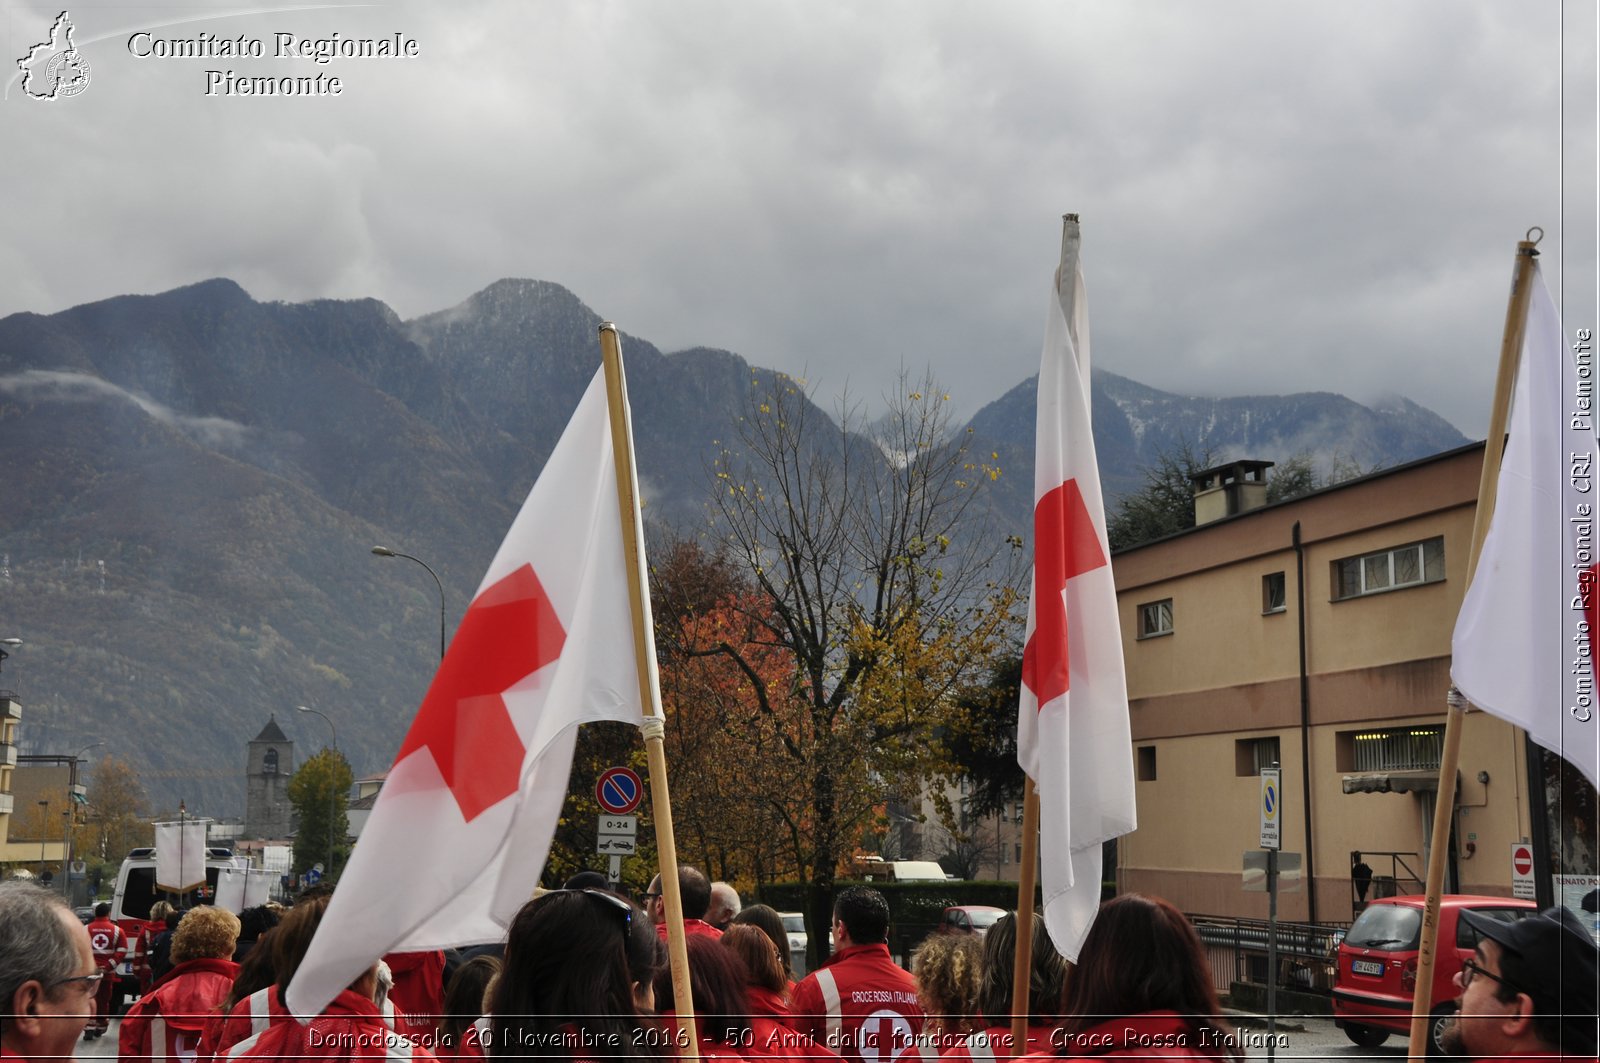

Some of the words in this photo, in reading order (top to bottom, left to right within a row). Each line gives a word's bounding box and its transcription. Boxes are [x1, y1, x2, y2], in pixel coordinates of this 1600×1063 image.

[1555, 877, 1586, 886] RENATO
[851, 991, 873, 1003] CROCE
[873, 991, 894, 1003] ROSSA
[893, 991, 918, 1006] ITALIANA
